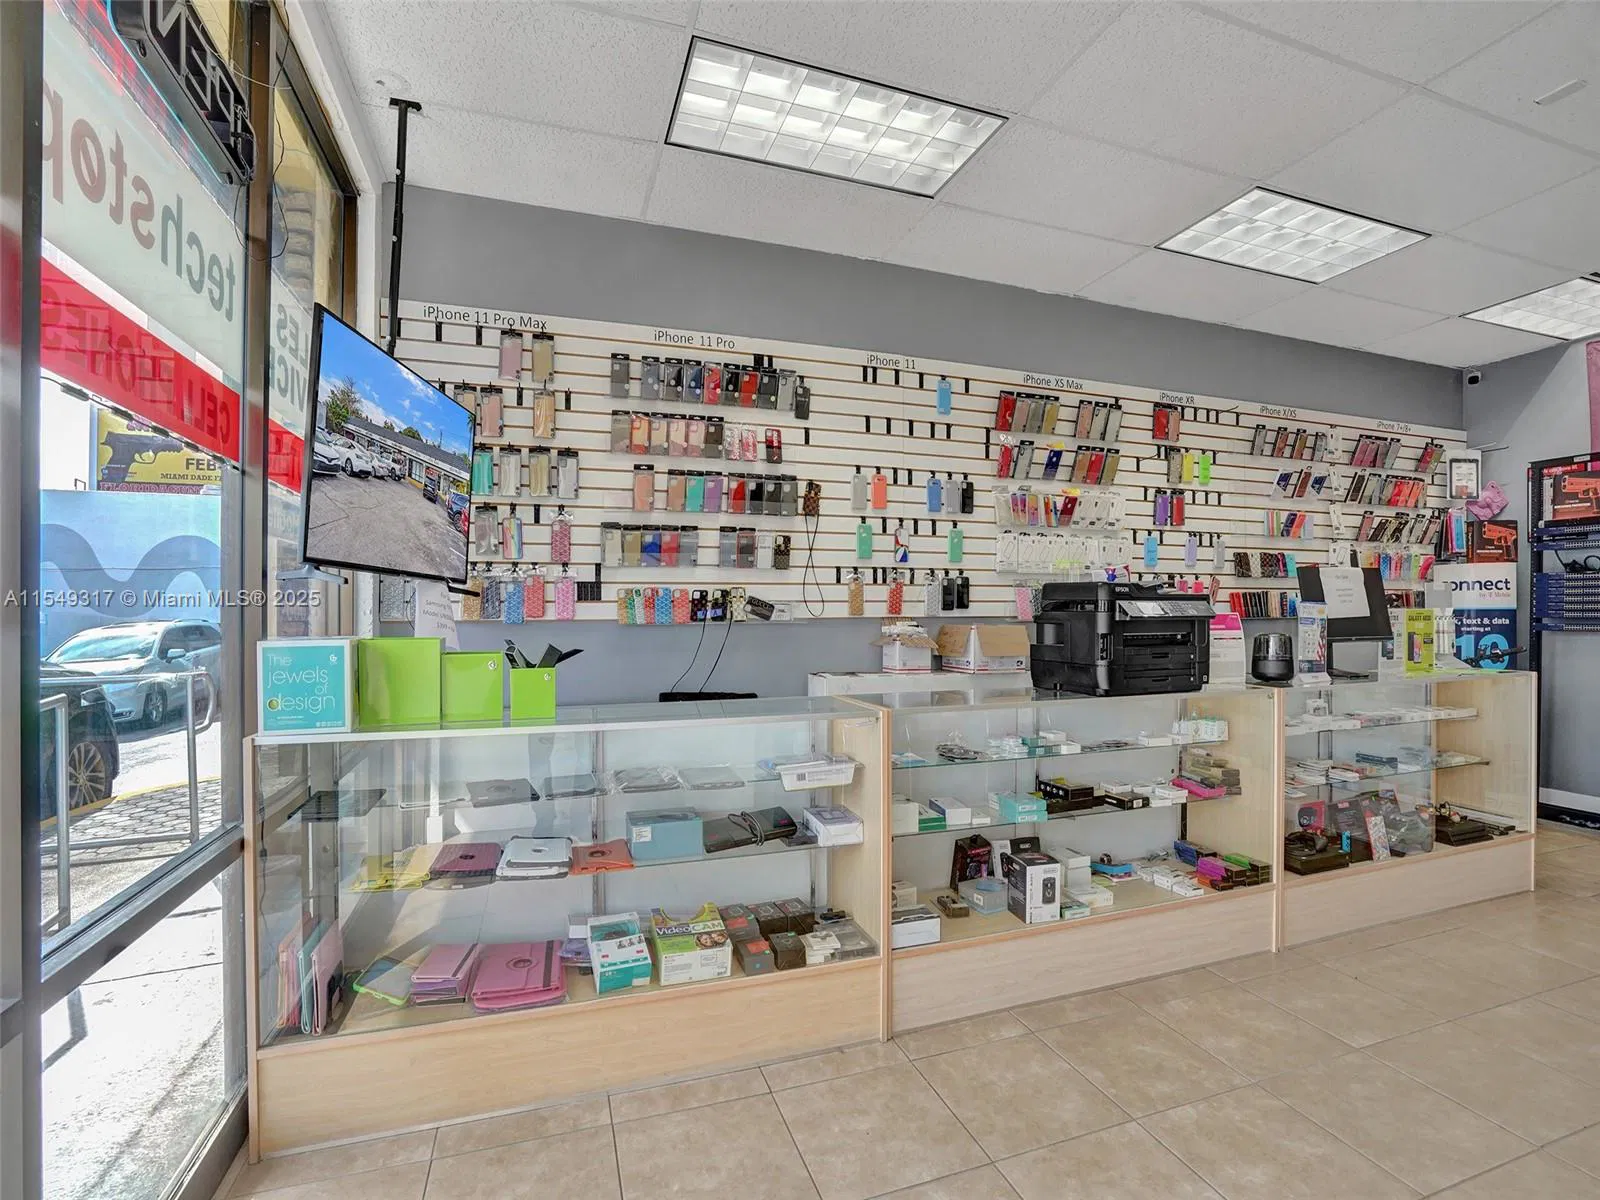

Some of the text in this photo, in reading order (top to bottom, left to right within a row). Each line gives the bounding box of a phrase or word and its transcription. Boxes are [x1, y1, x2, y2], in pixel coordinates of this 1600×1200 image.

[423, 305, 548, 330] iPhone 11 Pro Max
[653, 329, 736, 350] iPhone 11 Pro
[866, 354, 917, 370] iPhone 11
[1023, 374, 1084, 391] iPhone XS Max
[1159, 391, 1195, 405] iPhone XR
[1259, 405, 1297, 419] iPhone X/XS
[1376, 420, 1396, 431] iPhone
[160, 472, 189, 481] MIAMI
[190, 473, 213, 482] DADE
[1443, 578, 1511, 592] onnect
[1463, 617, 1482, 625] text
[1492, 617, 1510, 625] data
[267, 654, 293, 667] The
[267, 666, 329, 689] jewels
[314, 682, 329, 696] of
[266, 693, 336, 714] design
